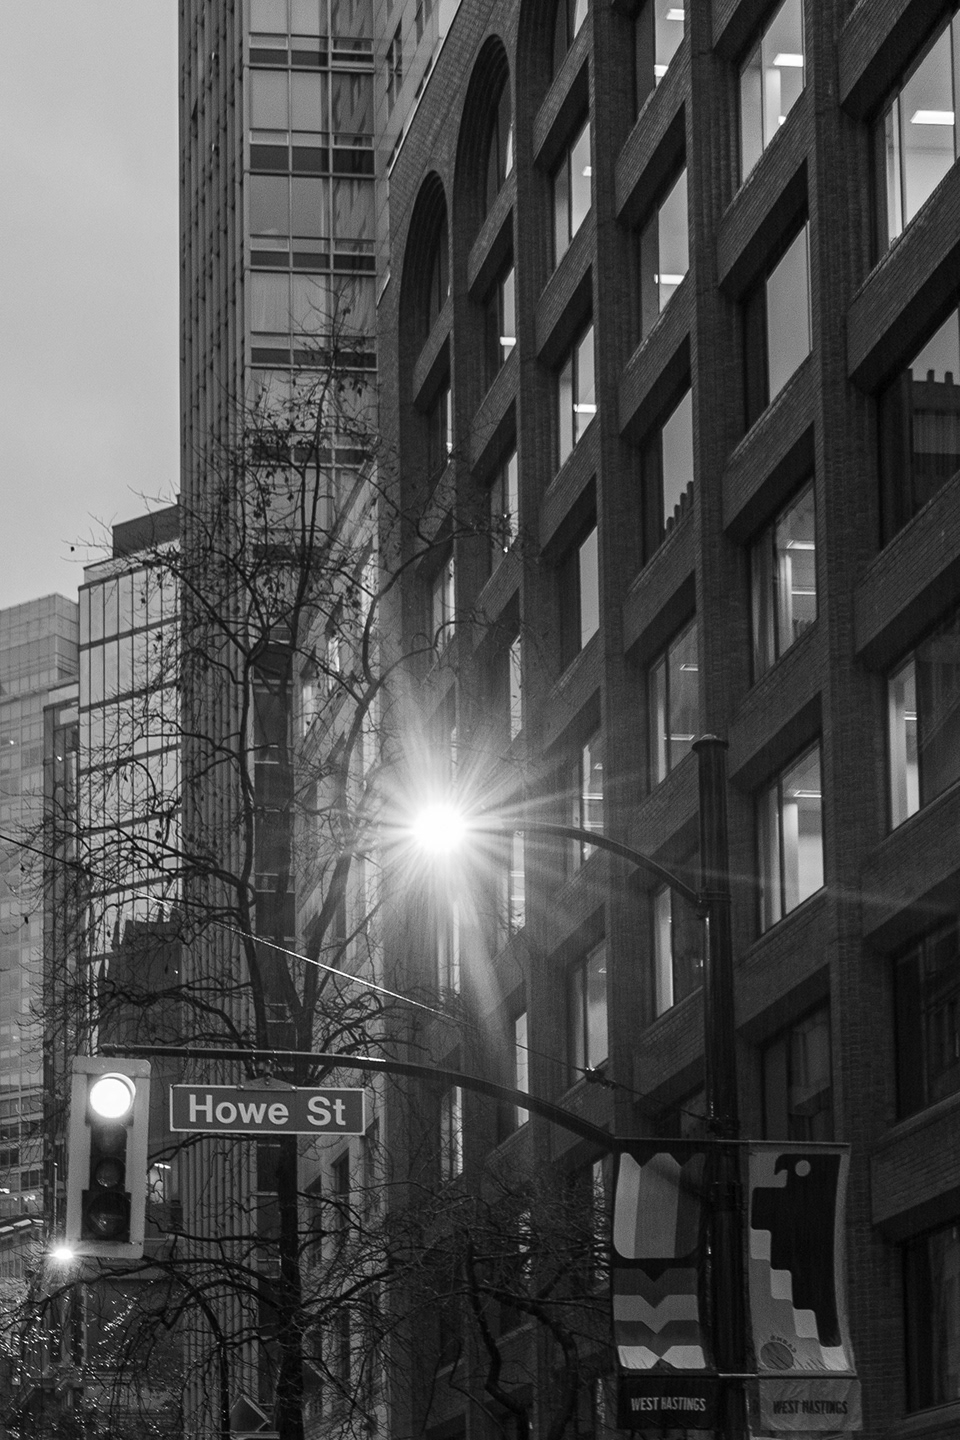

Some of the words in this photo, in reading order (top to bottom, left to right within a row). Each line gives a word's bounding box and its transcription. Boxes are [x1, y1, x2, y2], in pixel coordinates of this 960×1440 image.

[188, 1094, 289, 1125] Howe
[306, 1096, 346, 1126] St
[631, 1397, 659, 1411] WEST
[660, 1397, 706, 1412] HASTINGS
[773, 1400, 800, 1415] WEST
[802, 1400, 848, 1415] HASTINGS
